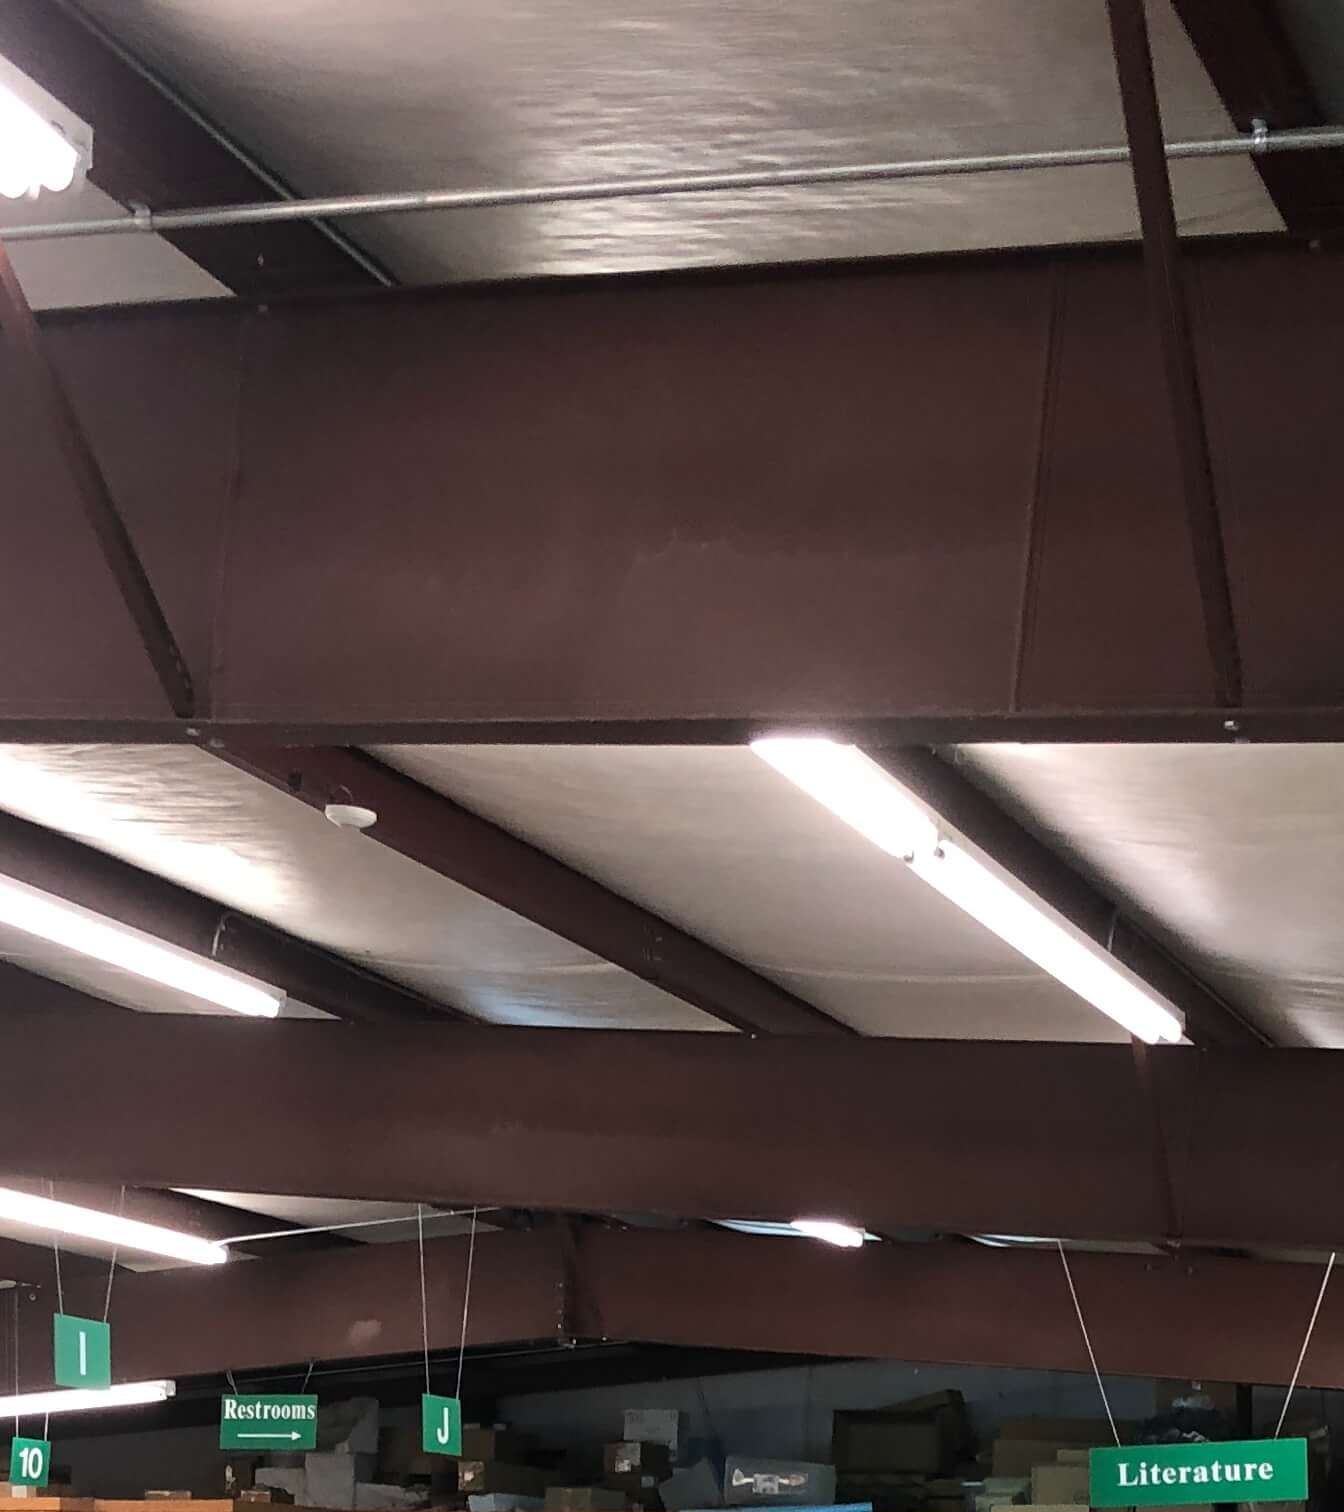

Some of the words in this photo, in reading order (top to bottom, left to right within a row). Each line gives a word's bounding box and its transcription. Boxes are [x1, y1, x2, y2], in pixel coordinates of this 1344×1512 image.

[223, 1399, 316, 1420] Restrooms
[437, 1406, 449, 1445] J
[18, 1447, 43, 1479] 10
[1116, 1459, 1275, 1487] Literature
